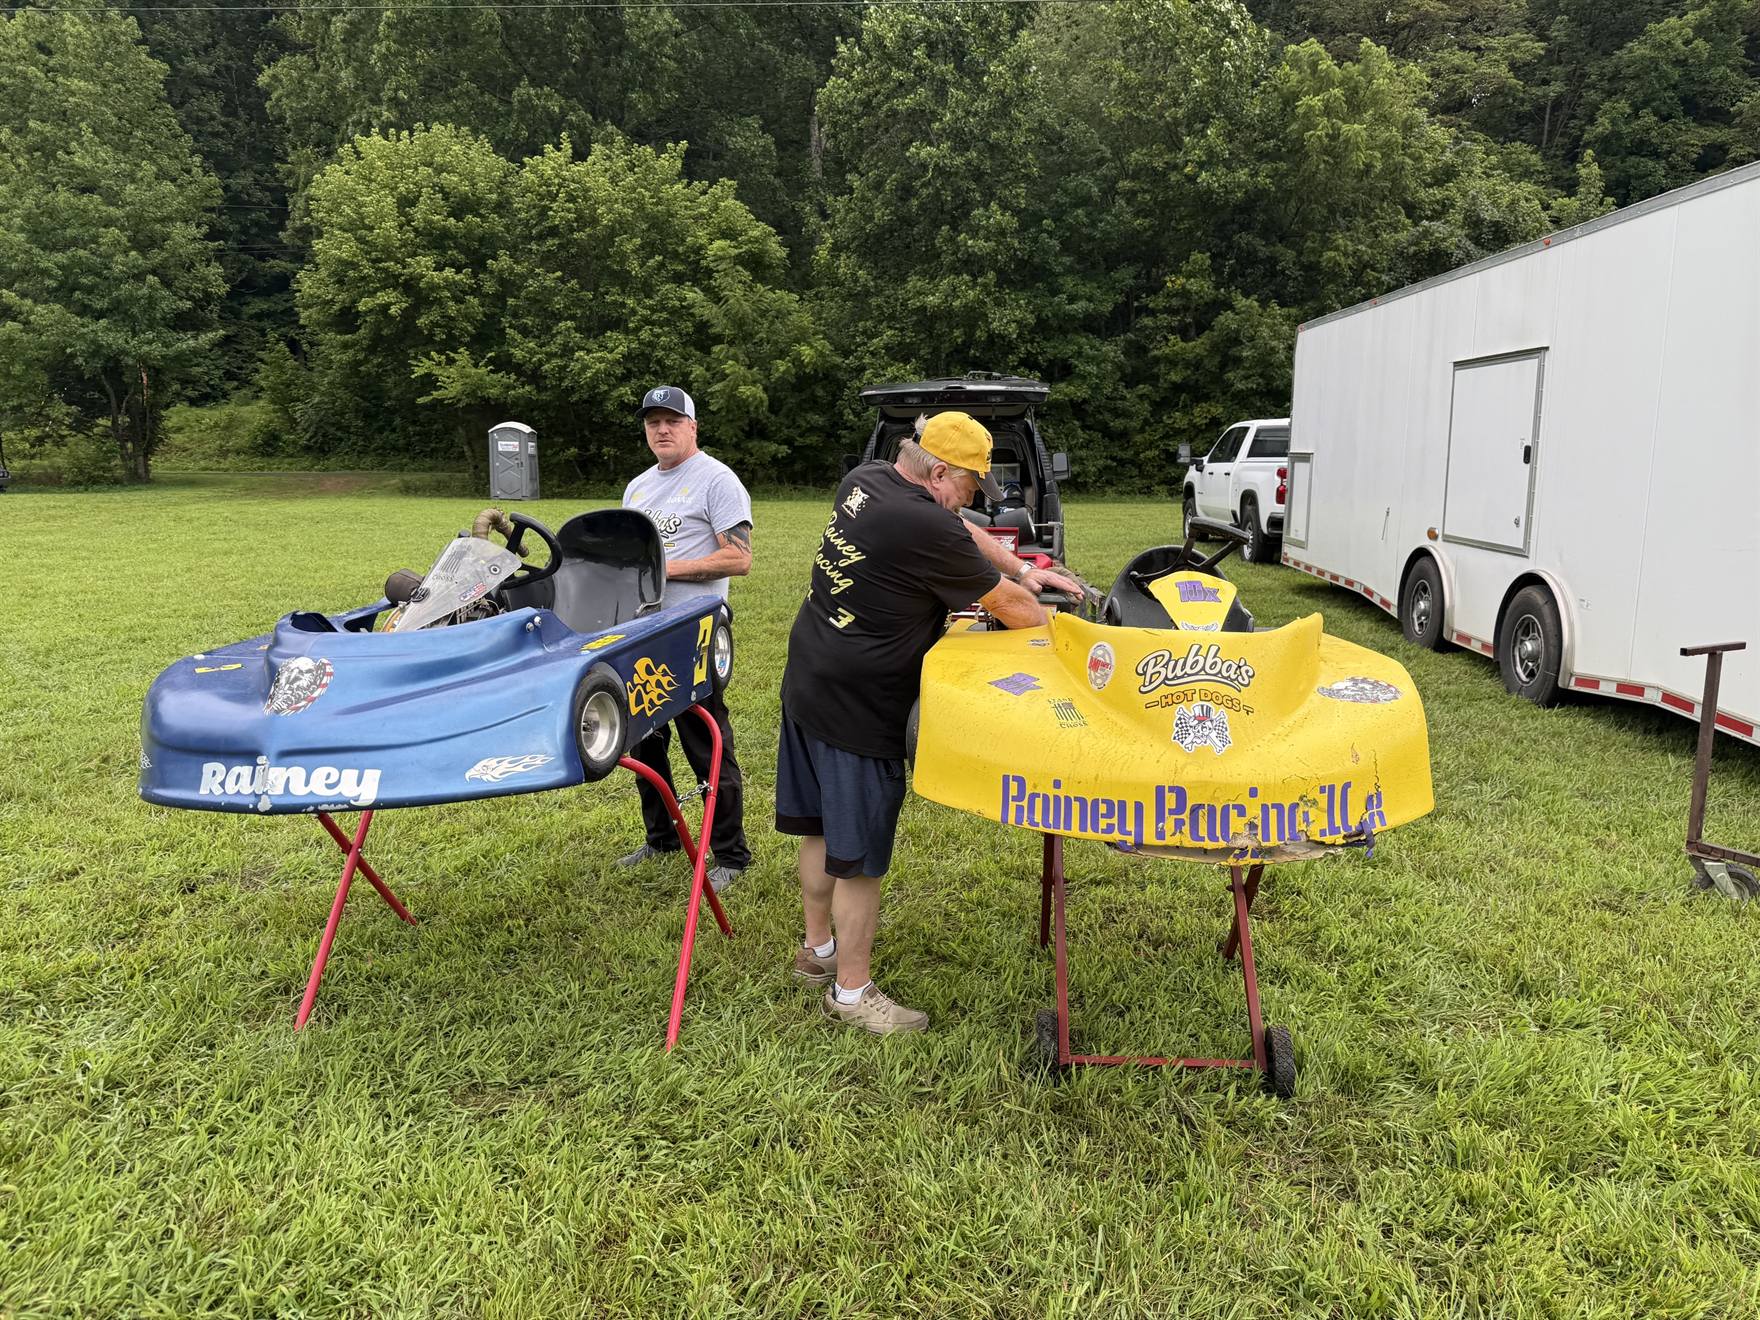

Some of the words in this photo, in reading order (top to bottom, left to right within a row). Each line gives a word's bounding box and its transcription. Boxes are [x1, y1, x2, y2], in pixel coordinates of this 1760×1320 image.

[1175, 580, 1222, 603] 10x
[829, 607, 856, 629] 3
[1136, 644, 1255, 694] Bubba's
[1160, 689, 1197, 709] HOT
[1198, 689, 1242, 712] DOGS
[199, 755, 382, 807] Rainey
[1000, 774, 1145, 854] Rainey
